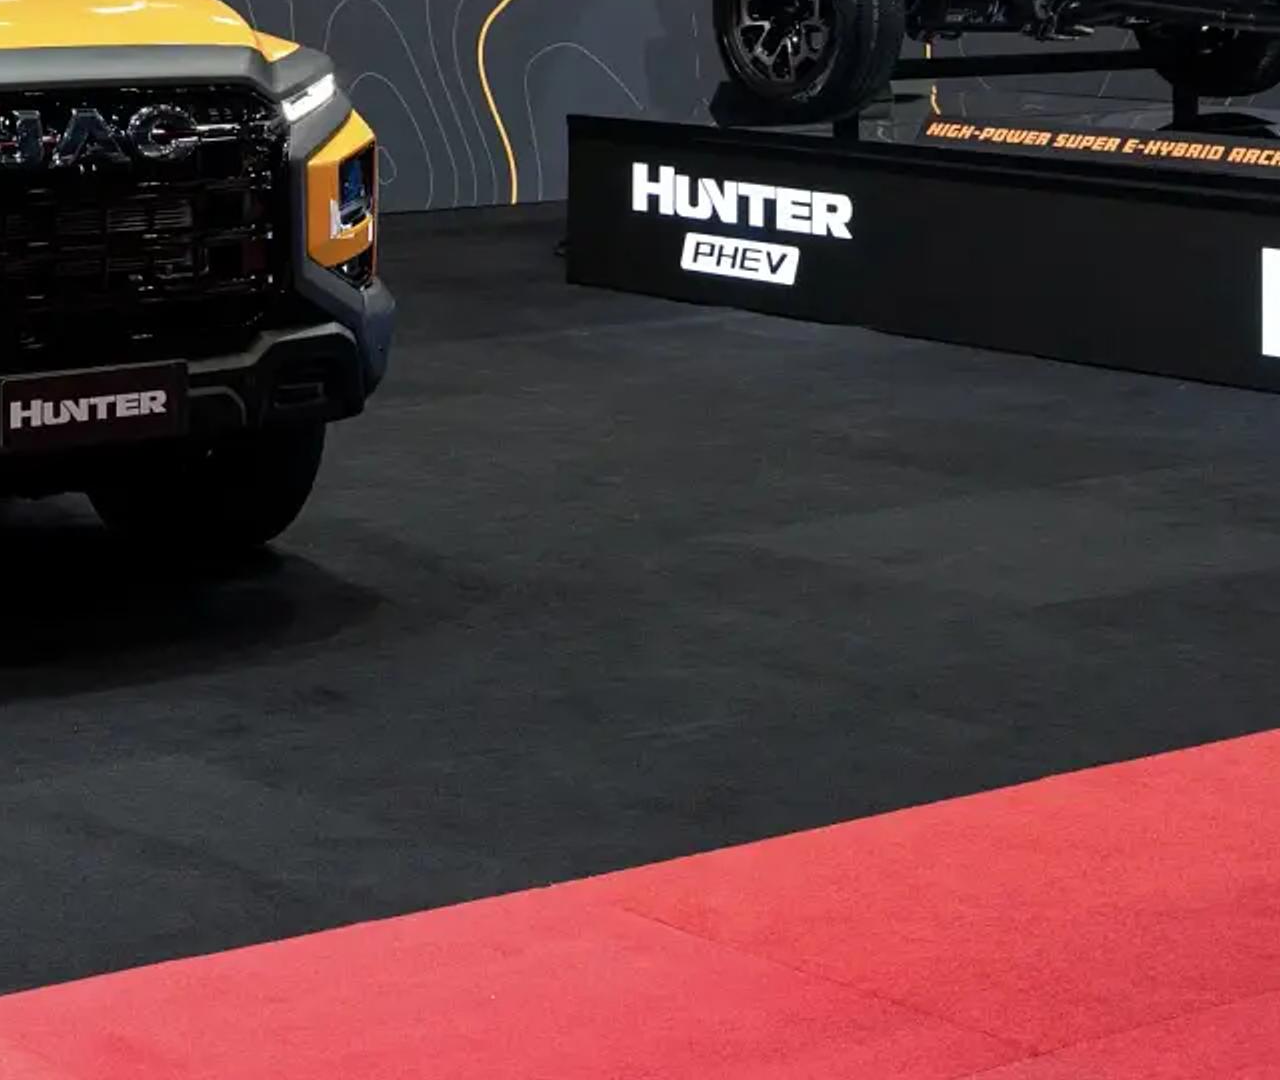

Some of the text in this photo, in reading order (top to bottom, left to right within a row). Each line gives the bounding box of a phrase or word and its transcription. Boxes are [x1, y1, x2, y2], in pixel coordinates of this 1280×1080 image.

[926, 122, 1051, 146] HIGH-POWER
[1053, 133, 1119, 152] SUPER
[1122, 138, 1223, 161] E-HYBRID
[632, 162, 853, 240] HUNTER
[692, 241, 788, 275] PHEV
[10, 390, 166, 429] HUNTER
